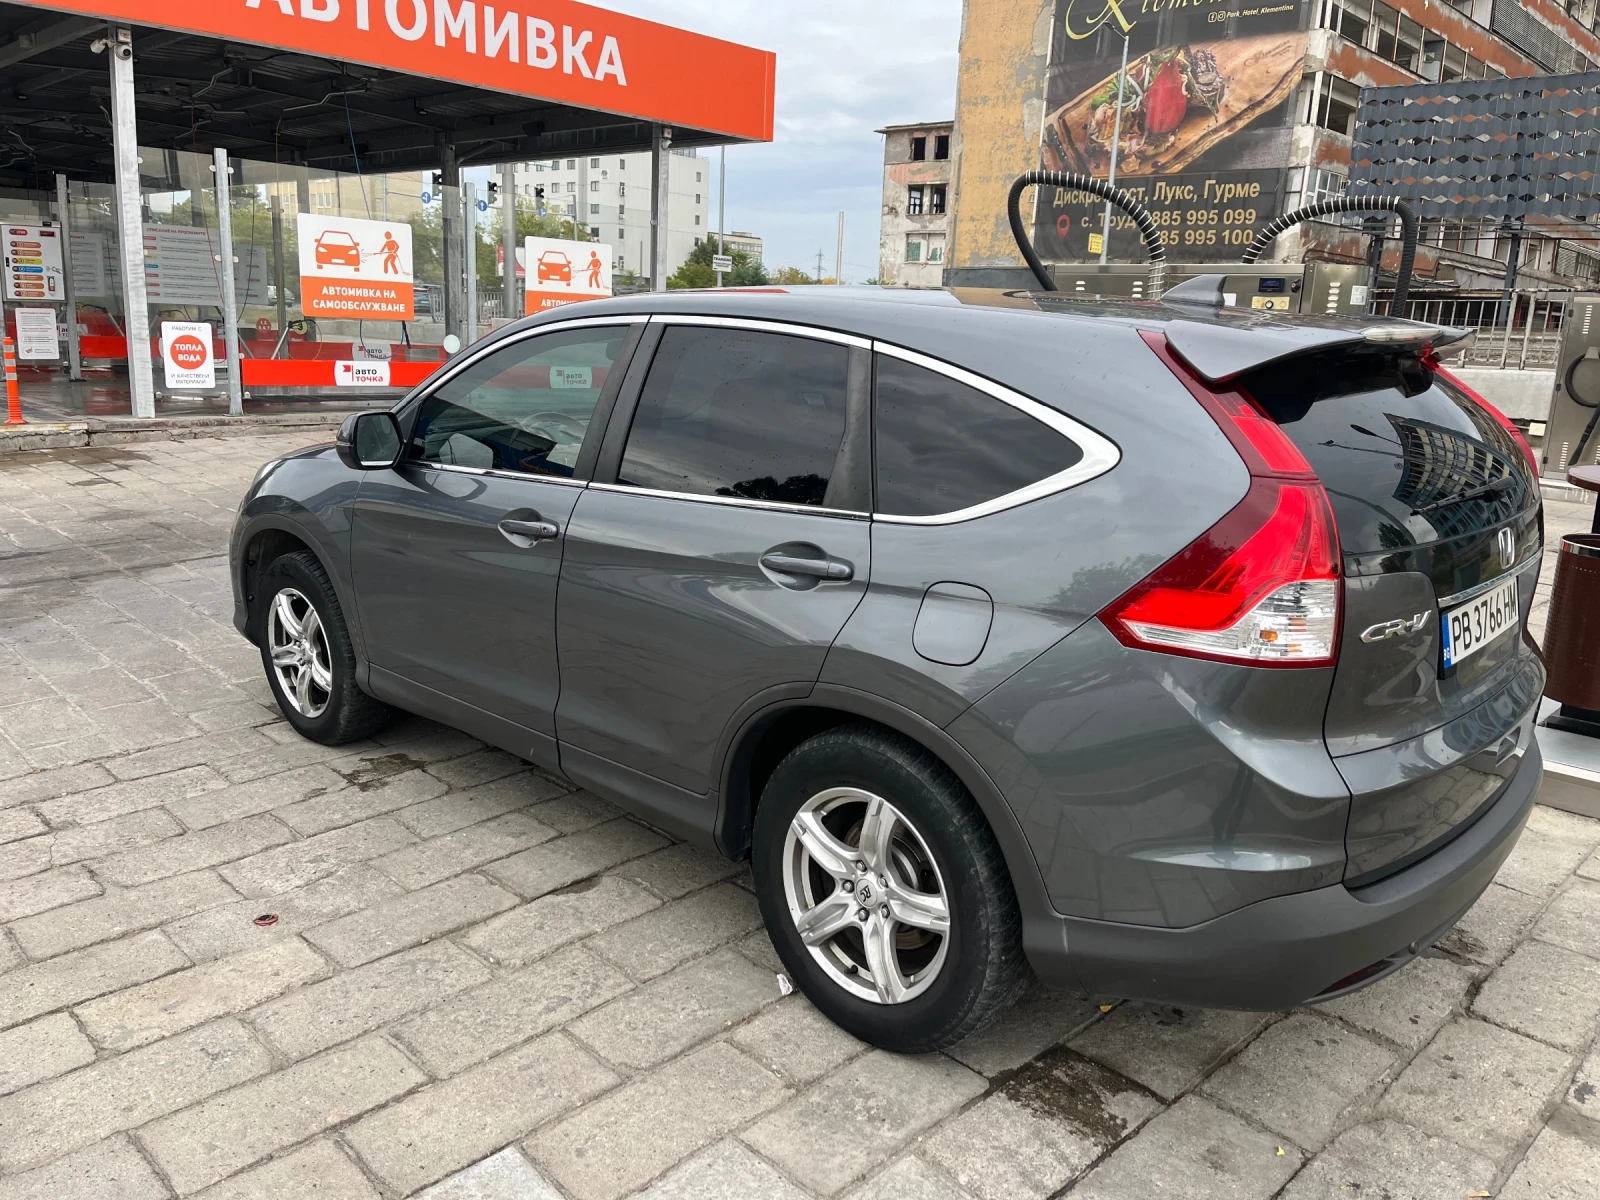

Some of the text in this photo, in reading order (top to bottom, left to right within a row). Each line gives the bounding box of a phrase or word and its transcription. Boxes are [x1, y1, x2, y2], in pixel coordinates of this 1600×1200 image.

[1226, 4, 1294, 19] Park_Hotel_Klementina
[245, 0, 627, 86] ТОМИВКА
[1053, 179, 1260, 207] Дискрест, Лукс, Гурме
[1081, 216, 1092, 228] с.
[1147, 210, 1182, 226] 885
[1186, 210, 1218, 225] 995
[1223, 208, 1256, 224] 099
[1184, 230, 1216, 245] 995
[1221, 230, 1254, 245] 100
[322, 286, 396, 298] АВТОМИВКА НА
[313, 299, 406, 312] САМООБСЛУЖВАНЕ
[178, 354, 201, 362] ВОДА
[1359, 610, 1432, 644] CR-V
[1452, 582, 1517, 656] PB 3766 HM
